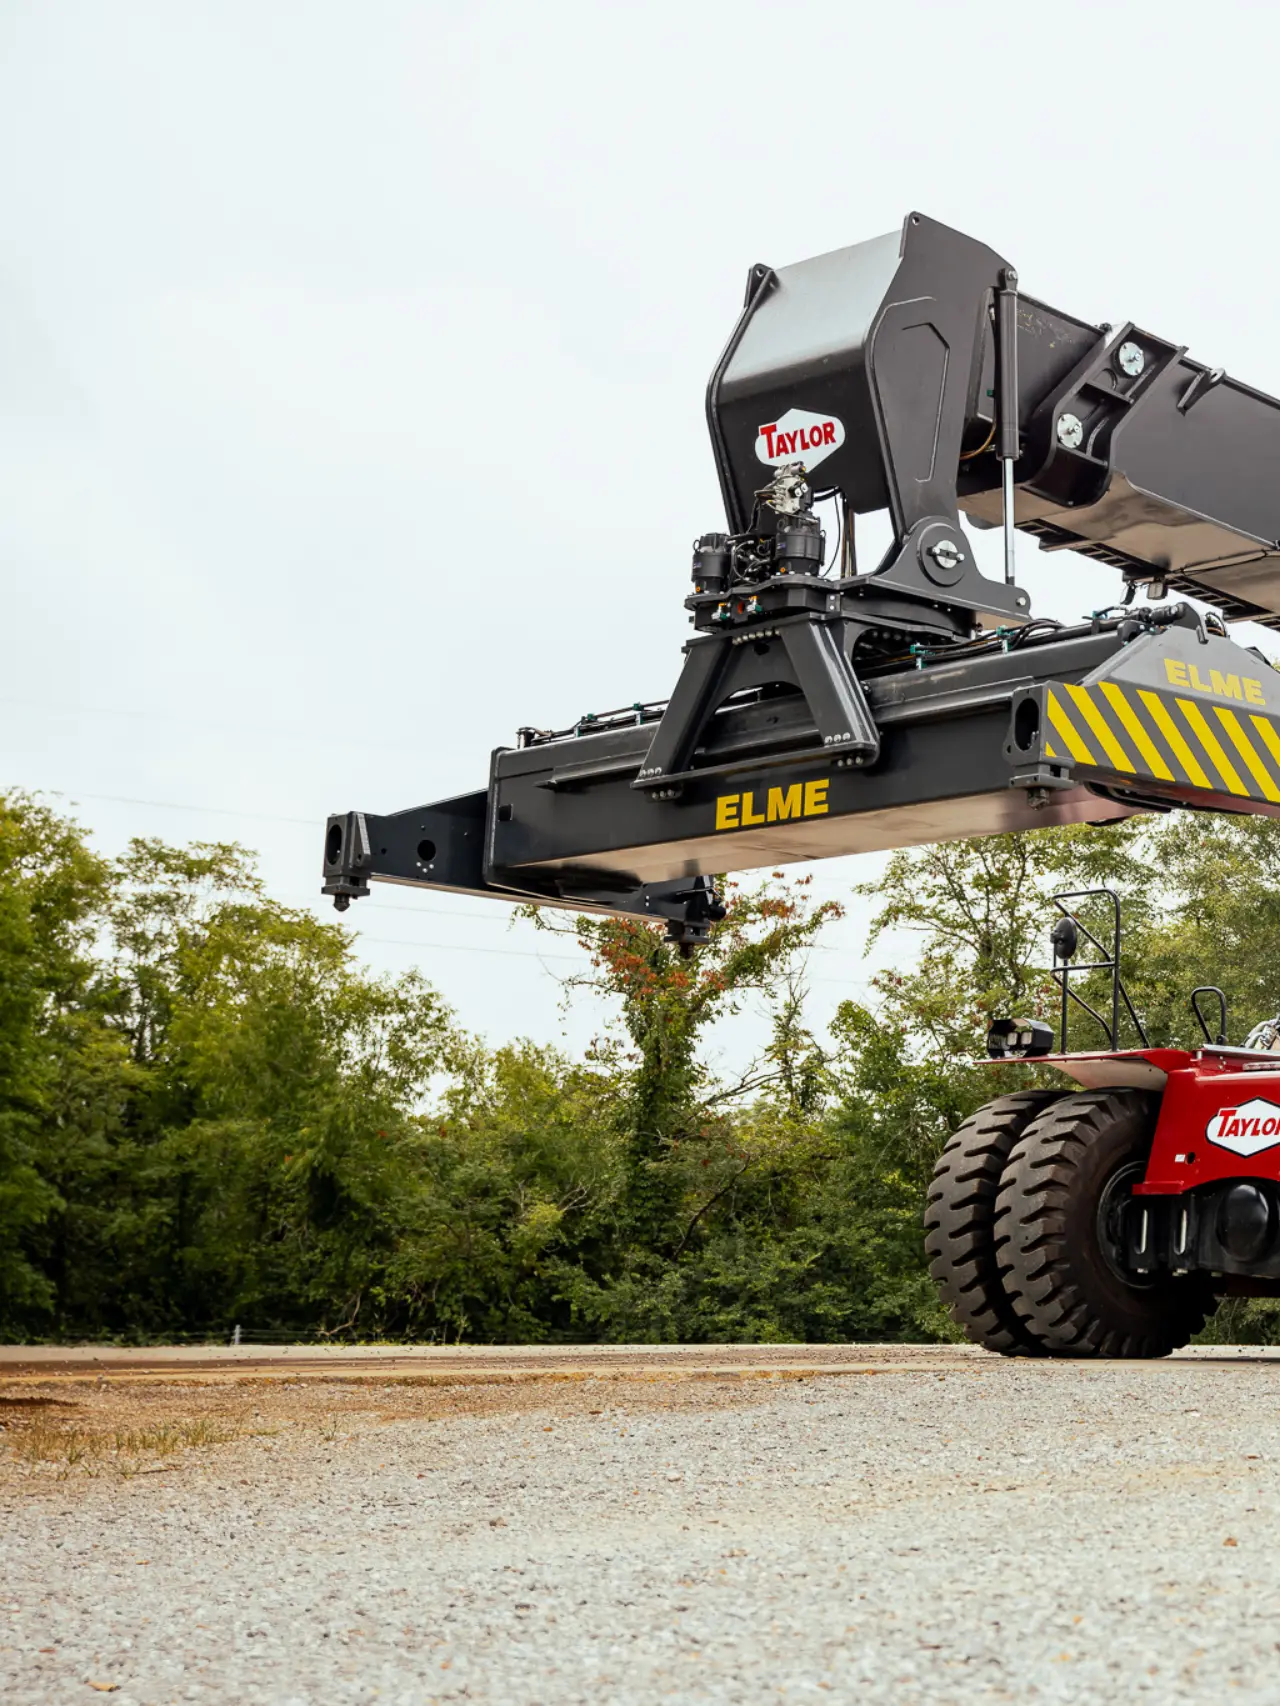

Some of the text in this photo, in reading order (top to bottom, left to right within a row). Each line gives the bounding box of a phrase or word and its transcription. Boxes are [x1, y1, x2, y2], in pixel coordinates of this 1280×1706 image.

[760, 421, 836, 459] TAYLOR
[1164, 658, 1266, 706] ELME
[716, 778, 830, 831] ELME
